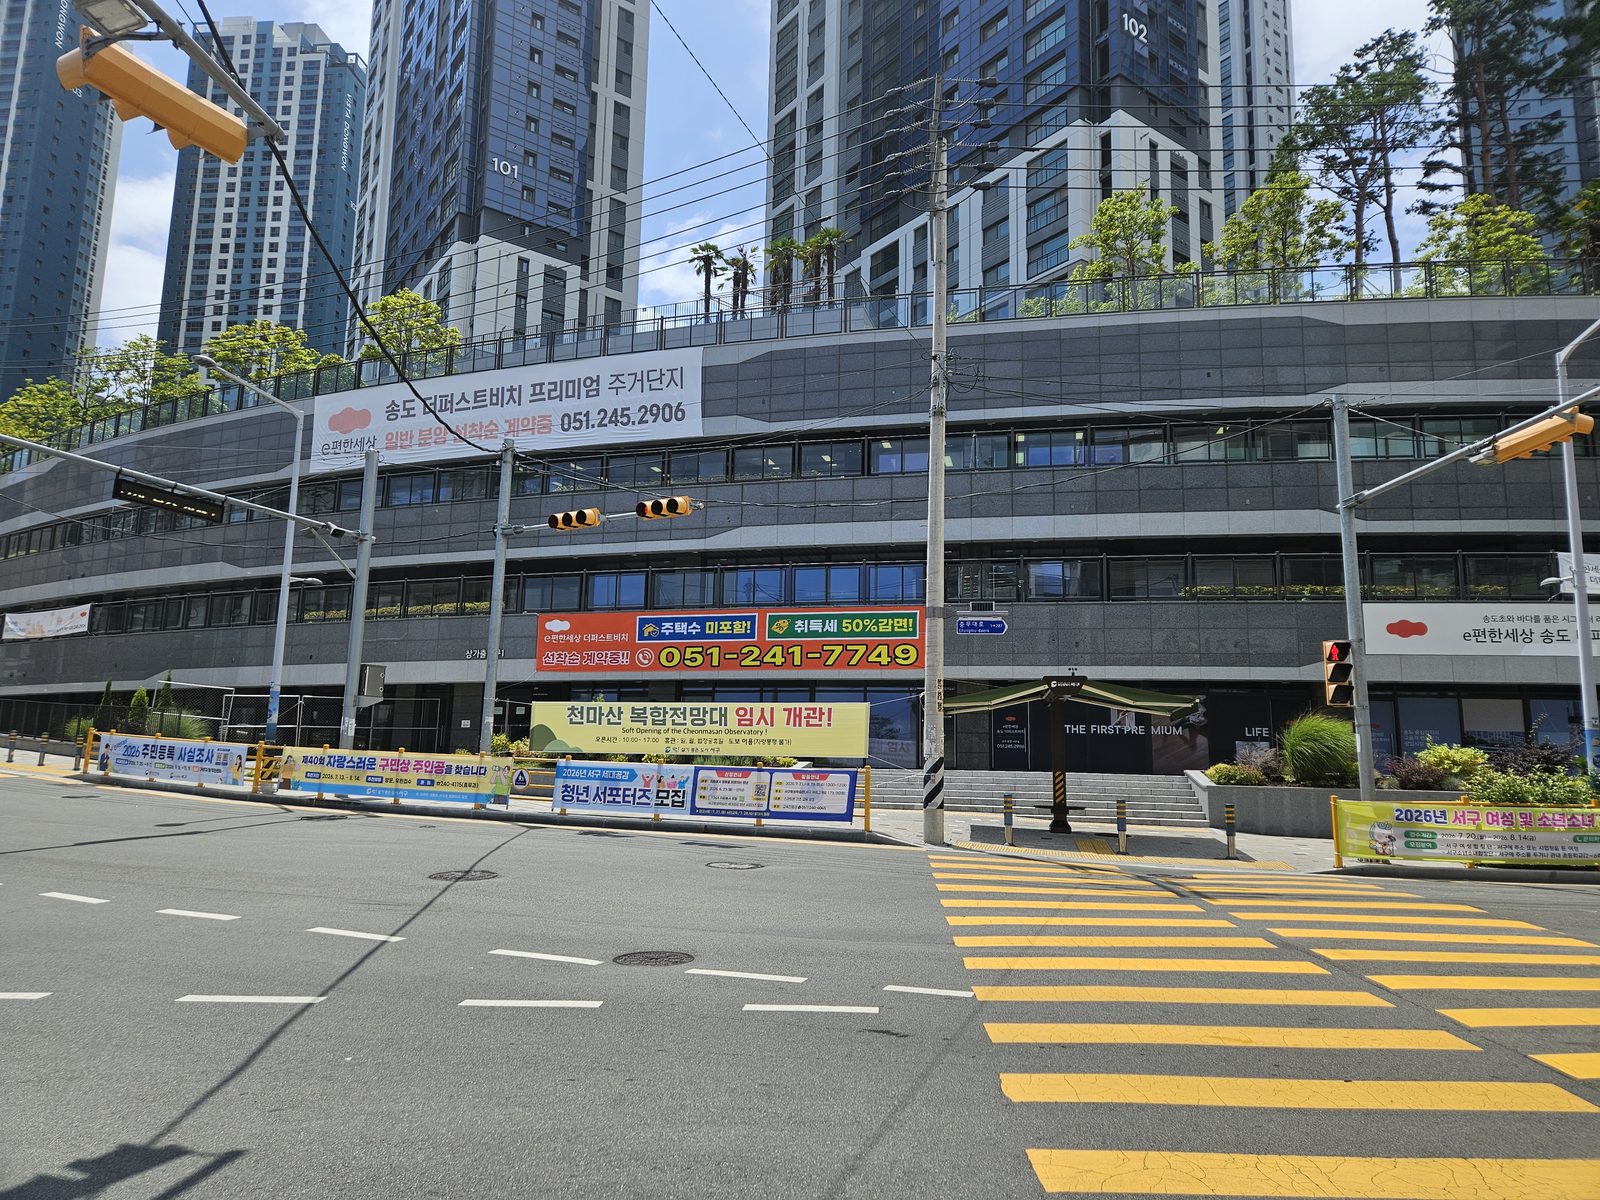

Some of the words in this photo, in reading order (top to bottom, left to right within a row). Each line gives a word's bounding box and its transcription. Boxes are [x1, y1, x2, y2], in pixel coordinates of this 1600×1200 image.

[1122, 13, 1148, 44] 102
[344, 94, 352, 119] VISTA
[341, 121, 350, 172] DONGWON
[492, 158, 518, 178] 101
[385, 399, 416, 421] 송도
[422, 384, 522, 415] 더퍼스트비치
[528, 374, 600, 403] 프리미엄
[608, 366, 684, 396] 주거단지
[385, 430, 414, 450] 일반
[418, 426, 448, 447] 분양
[454, 420, 500, 444] 선착순
[504, 414, 552, 438] 계약중
[560, 402, 686, 432] 051.245.2906
[322, 435, 377, 455] e편한세상
[661, 622, 700, 636] 주택수
[706, 621, 751, 634] 미포함!
[794, 620, 838, 633] 취득세
[842, 619, 913, 632] 50%감면!
[1482, 615, 1514, 623] 송도초와
[1517, 615, 1541, 623] 바다를
[1544, 615, 1559, 623] 품은
[544, 634, 581, 644] e편한세상
[583, 633, 629, 642] 더퍼스트비치
[1463, 628, 1534, 644] e편한세상
[1540, 628, 1571, 644] 송도
[543, 652, 580, 666] 선착순
[583, 651, 630, 665] 계약중!!
[658, 644, 918, 668] 051-241-7749
[567, 705, 624, 725] 천마산
[630, 706, 727, 726] 복합전망대
[735, 706, 775, 727] 임시
[783, 707, 833, 727] 개관!
[1064, 724, 1086, 734] THE
[1091, 725, 1123, 734] FIRST
[1124, 725, 1145, 735] PRE
[1152, 726, 1183, 736] MIUM
[1245, 727, 1269, 736] LIFE
[122, 745, 140, 757] 2026
[142, 744, 175, 760] 주민등록
[178, 748, 214, 764] 사실조사
[302, 755, 325, 765] 제40회
[326, 754, 376, 770] 자랑스러운
[379, 758, 410, 773] 구민상
[413, 759, 453, 775] 주인공을
[454, 765, 487, 776] 찾습니다
[562, 769, 586, 777] 2026년
[561, 784, 589, 803] 청년
[592, 786, 651, 806] 서포터즈
[654, 789, 686, 808] 모집
[1395, 808, 1448, 824] 2026년
[1452, 810, 1481, 825] 서구
[1486, 811, 1515, 826] 여성
[1518, 812, 1533, 827] 및
[1538, 812, 1595, 828] 소년소녀
